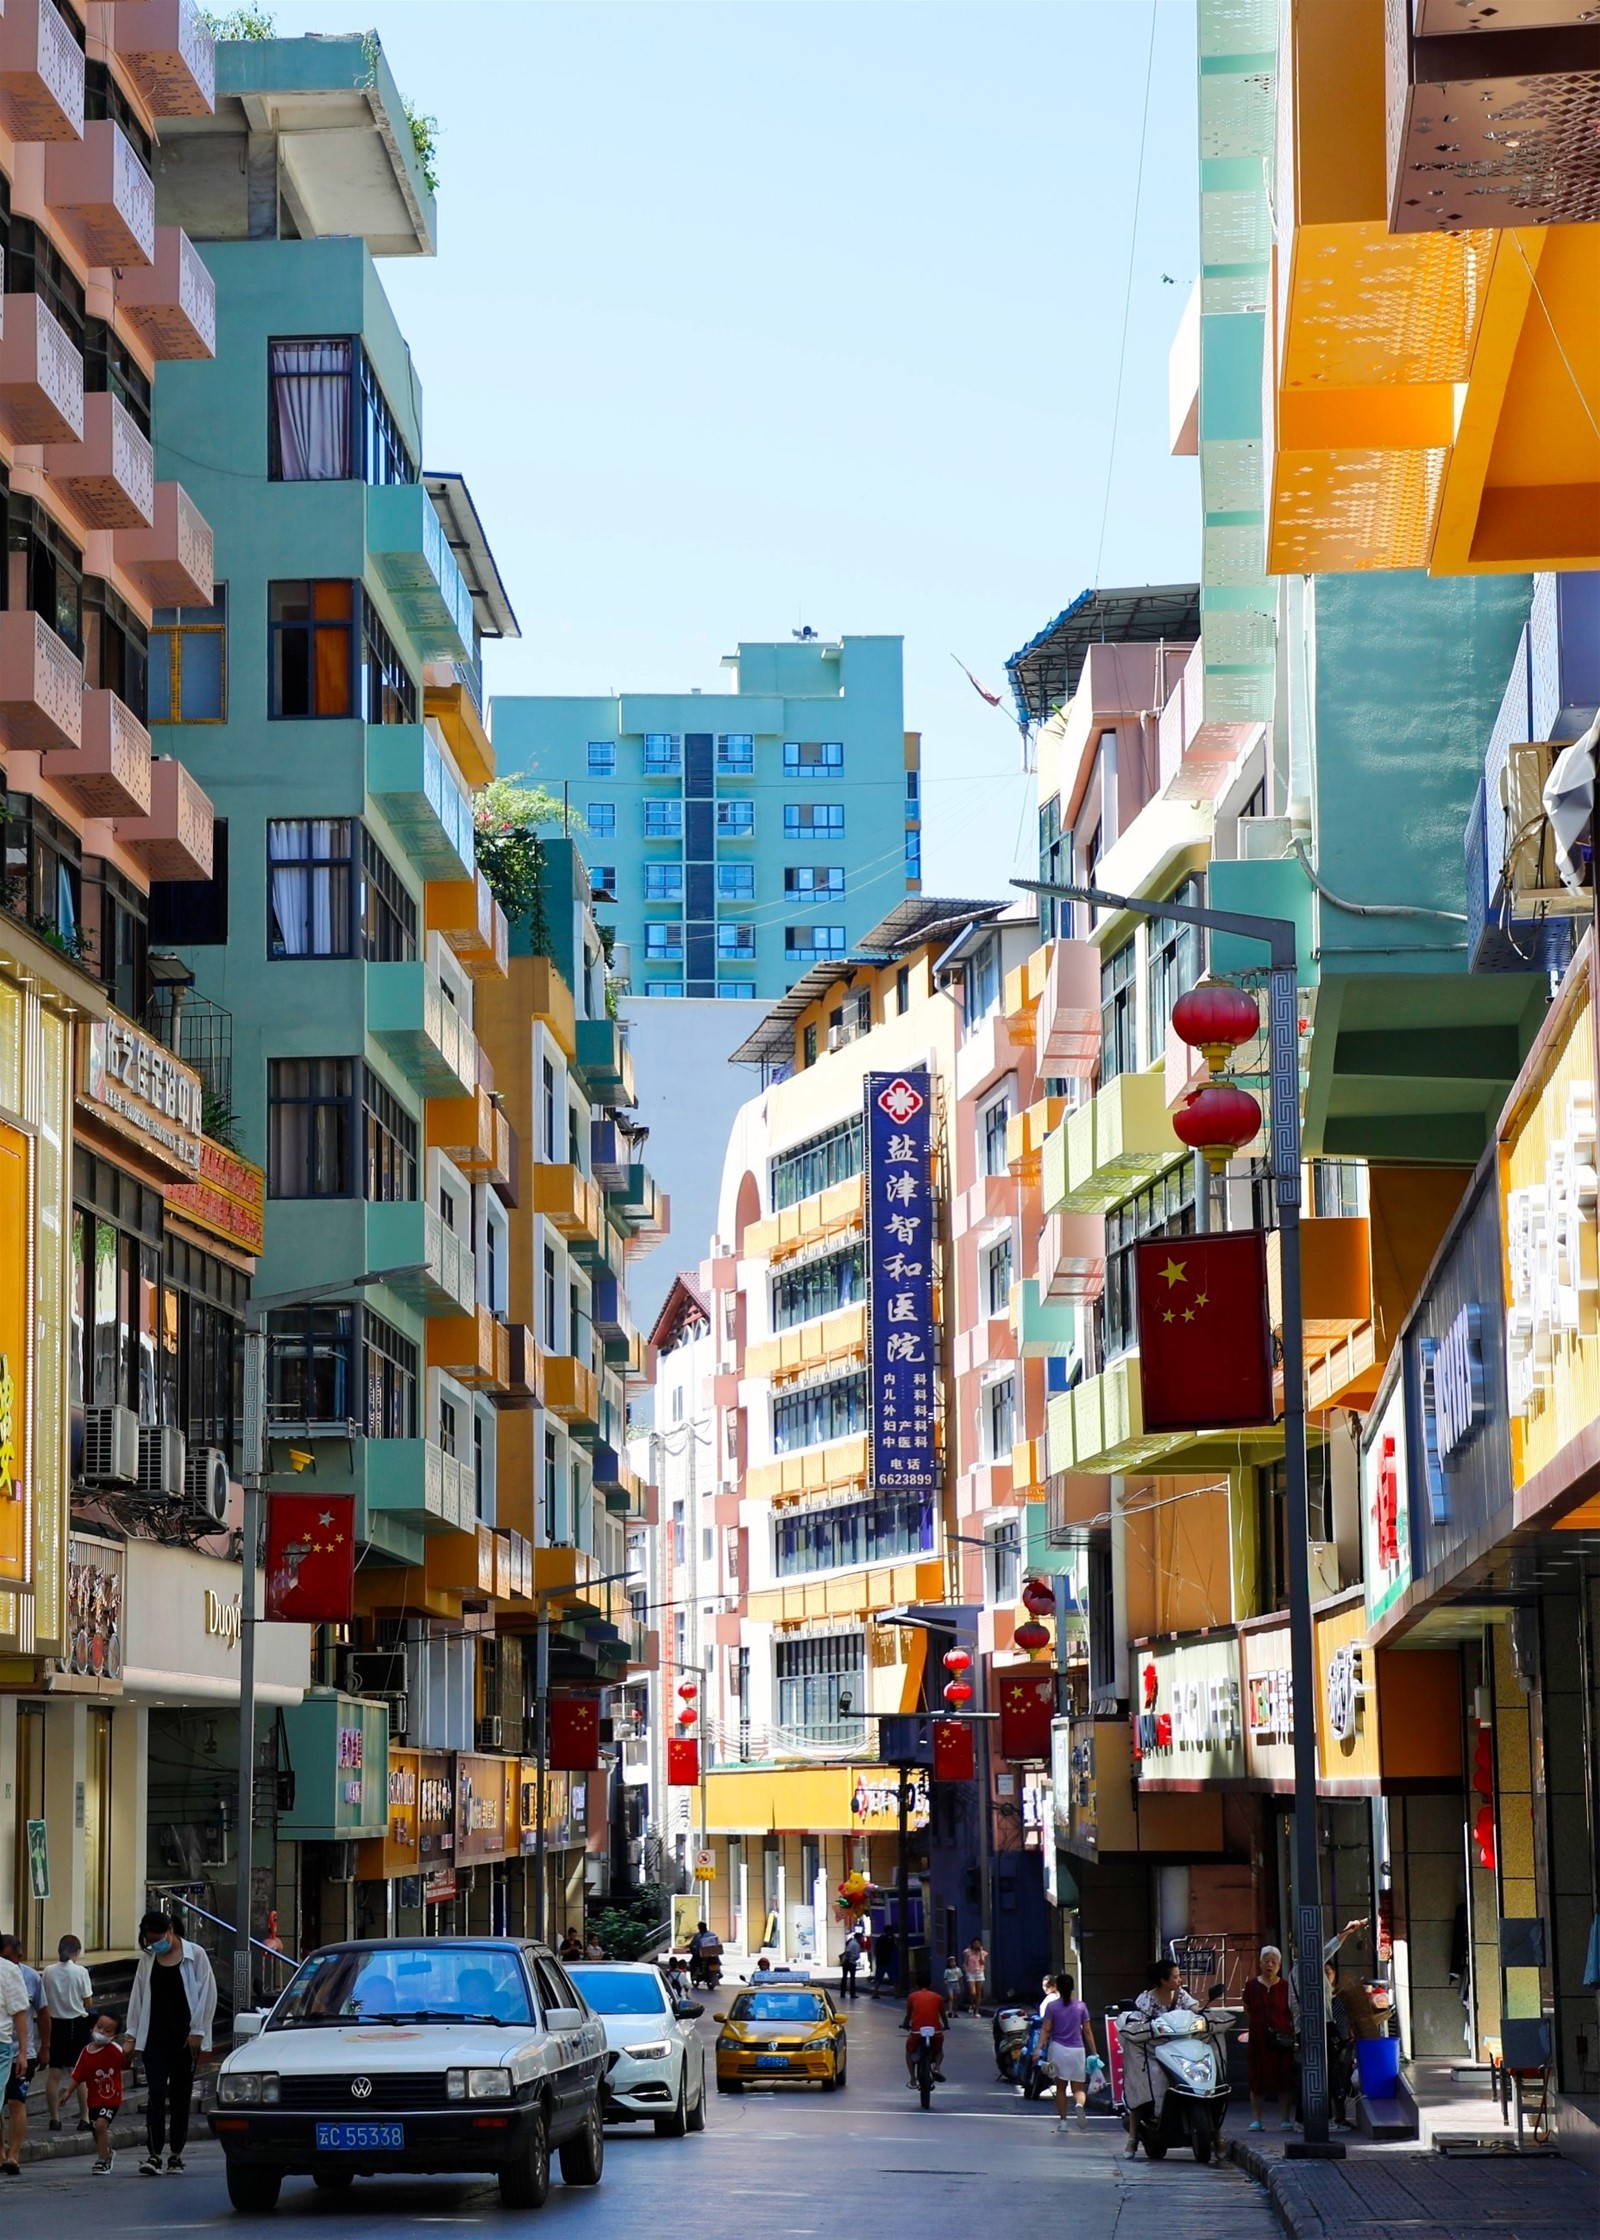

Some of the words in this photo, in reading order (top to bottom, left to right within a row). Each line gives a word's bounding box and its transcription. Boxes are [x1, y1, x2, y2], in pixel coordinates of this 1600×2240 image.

[882, 1133, 925, 1363] 盐津智和医院
[883, 1373, 927, 1386] 内科
[883, 1389, 928, 1402] 儿科
[883, 1405, 928, 1417] 外科
[883, 1420, 928, 1433] 妇产科
[882, 1436, 928, 1449] 中医科
[890, 1458, 921, 1471] 电话
[879, 1473, 932, 1485] 6623899
